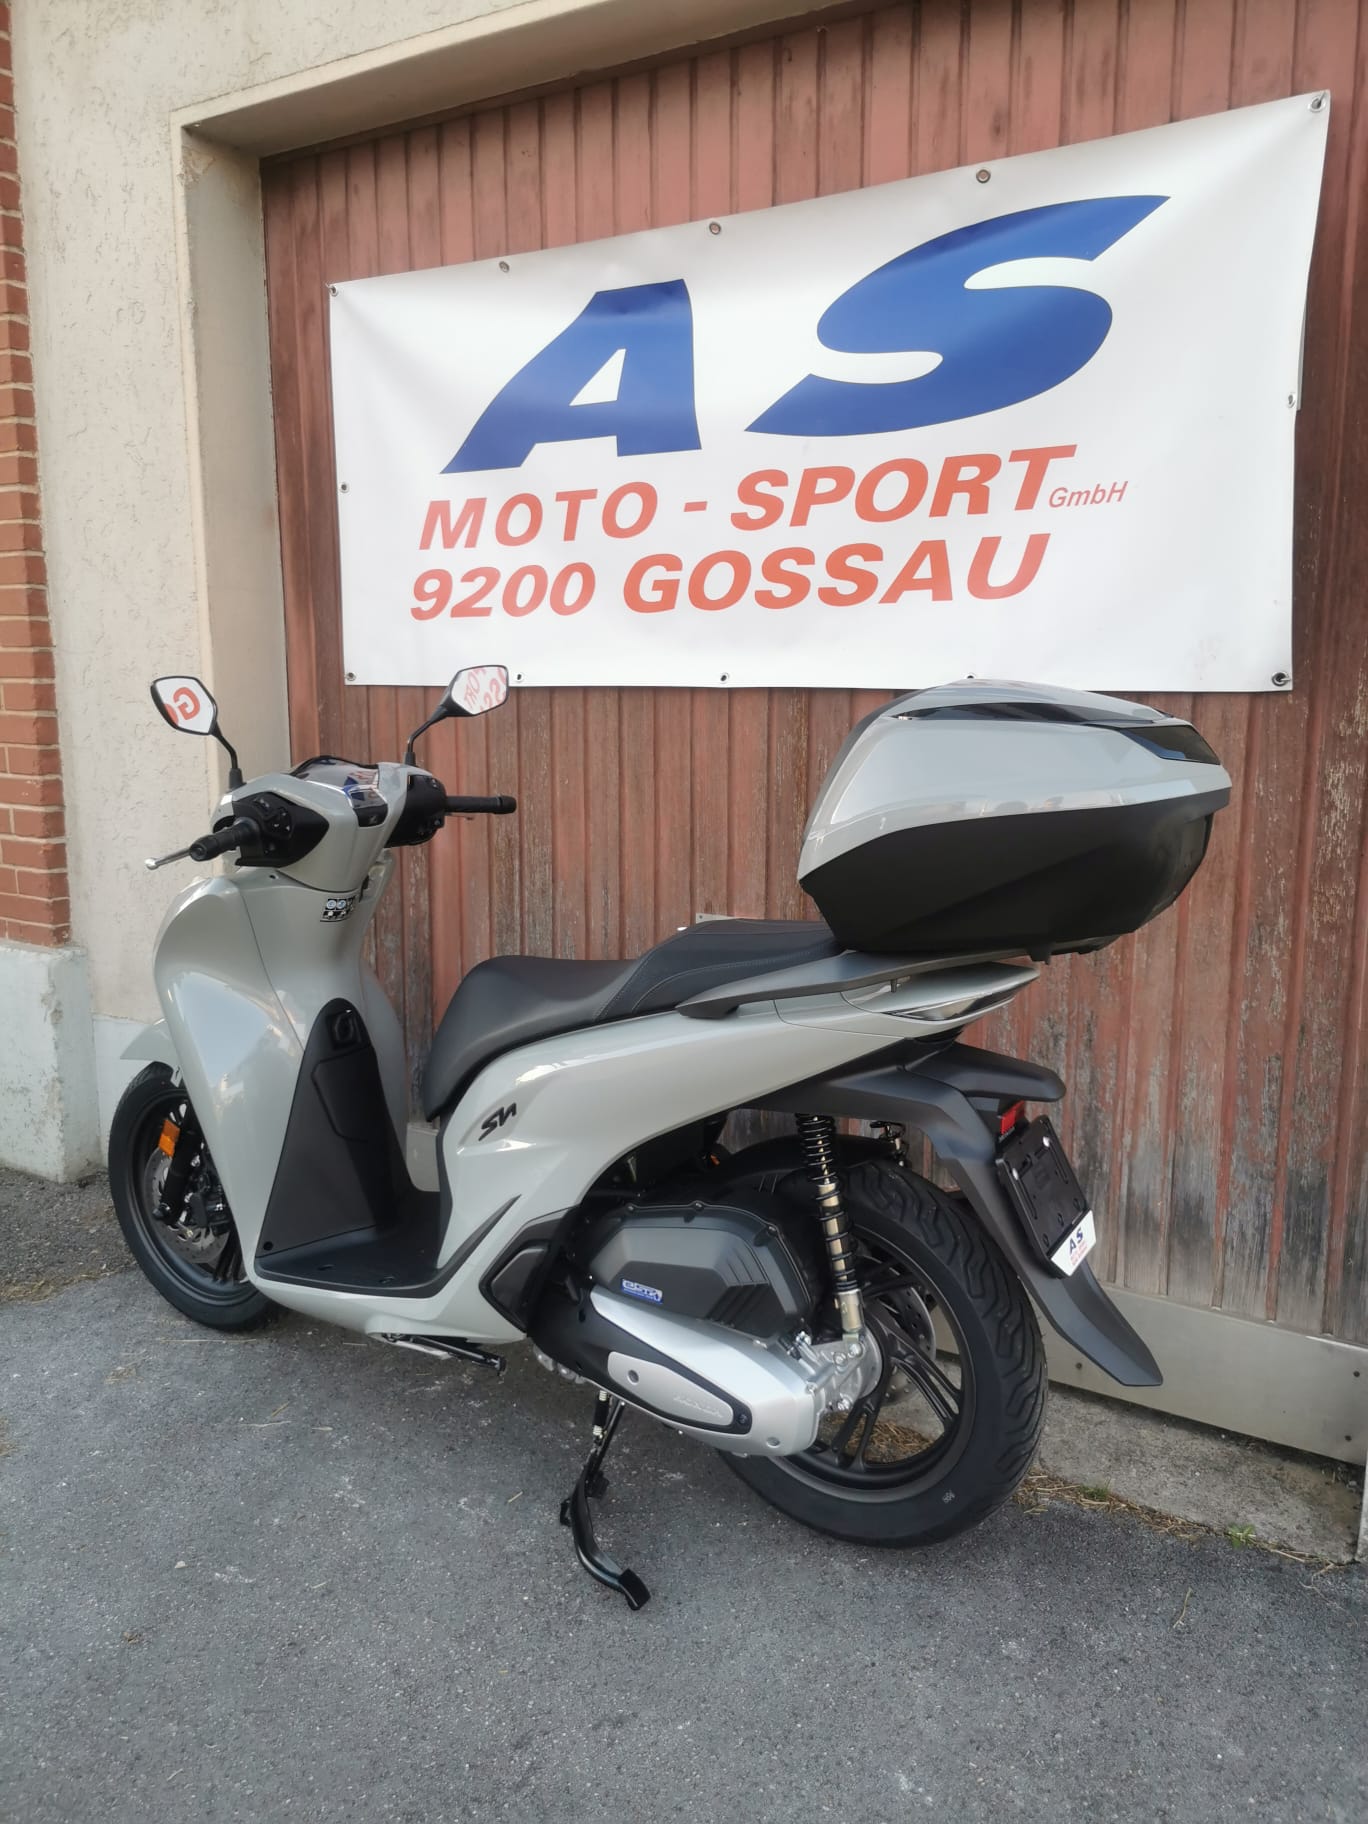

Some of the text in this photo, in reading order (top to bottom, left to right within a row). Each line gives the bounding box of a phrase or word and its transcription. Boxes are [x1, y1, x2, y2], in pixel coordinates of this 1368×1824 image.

[419, 490, 657, 550] MOTO
[730, 444, 1077, 532] SPORT
[1050, 481, 1129, 508] GmbH
[410, 533, 1050, 621] 9200 GOSSAU
